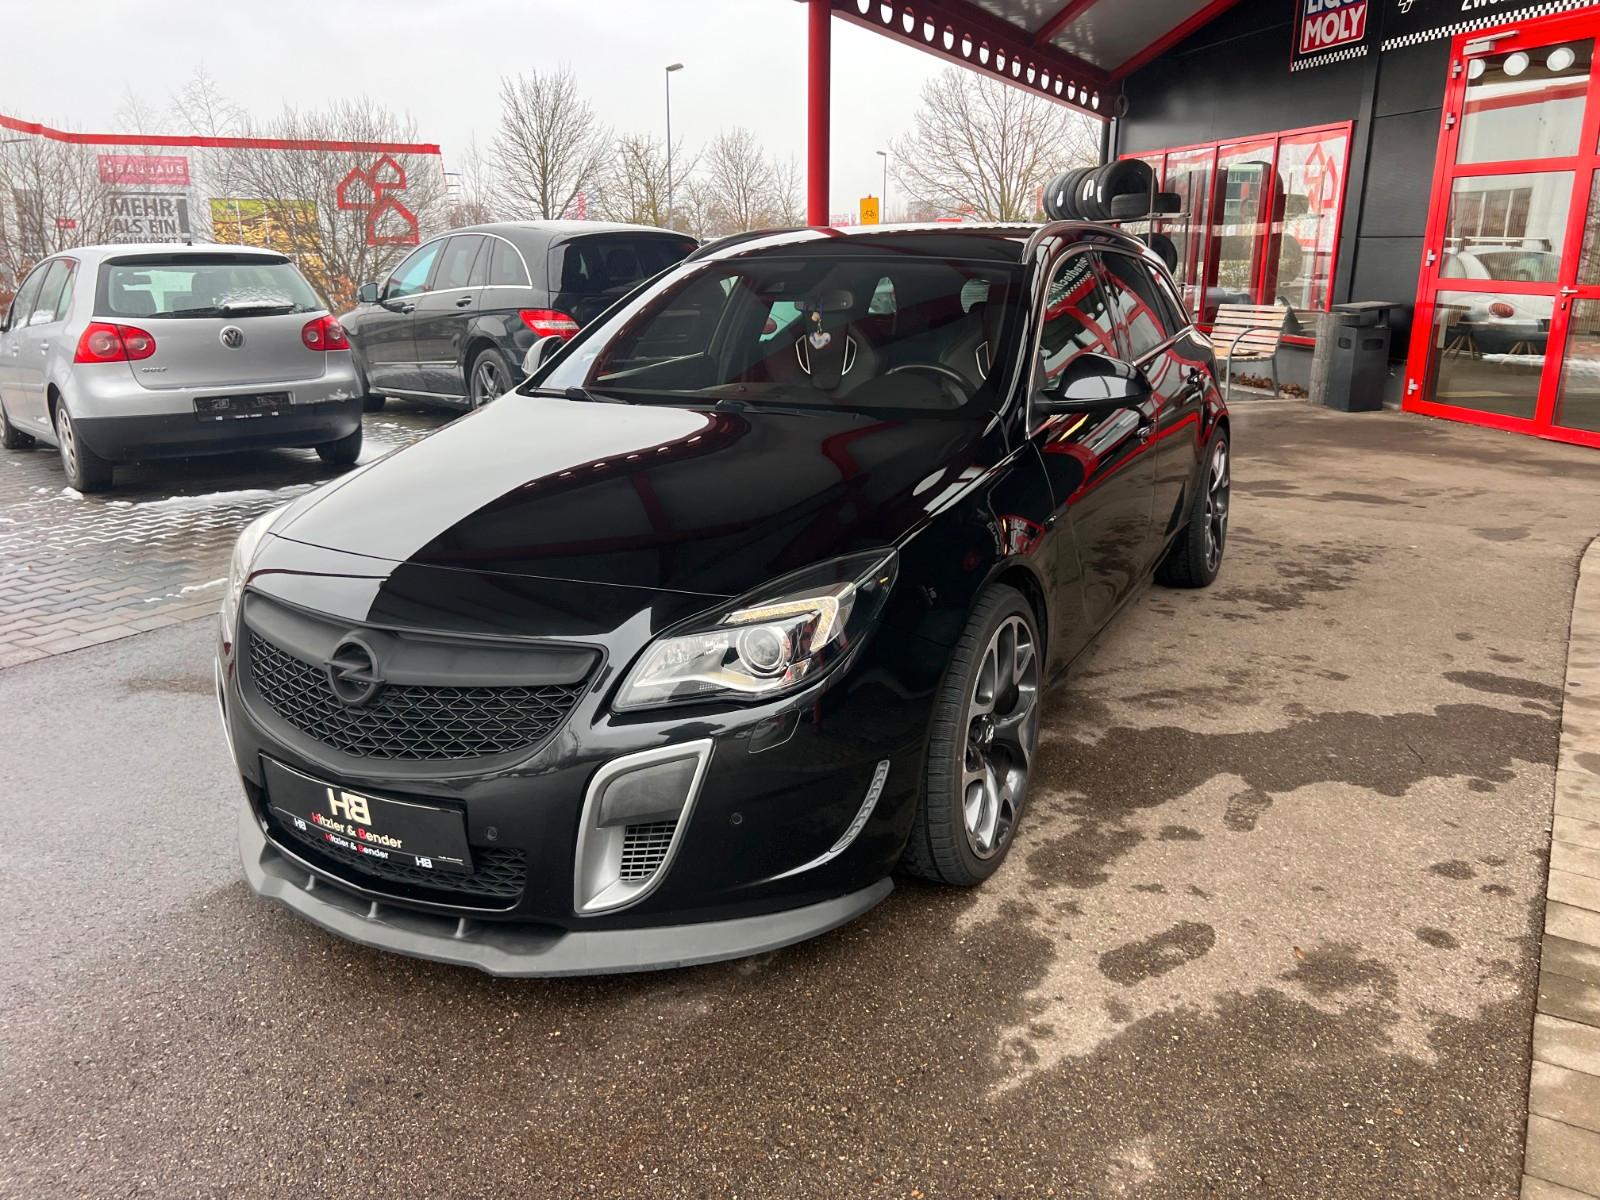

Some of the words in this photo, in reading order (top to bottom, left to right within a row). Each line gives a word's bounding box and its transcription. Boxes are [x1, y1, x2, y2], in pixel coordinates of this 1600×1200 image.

[1303, 4, 1365, 48] MOLY
[109, 198, 174, 217] MEHR
[113, 218, 144, 234] ALS
[149, 219, 177, 234] EIN
[311, 812, 345, 833] Hitzler
[346, 825, 357, 837] &
[357, 826, 403, 849] Bender
[358, 843, 389, 859] Bender
